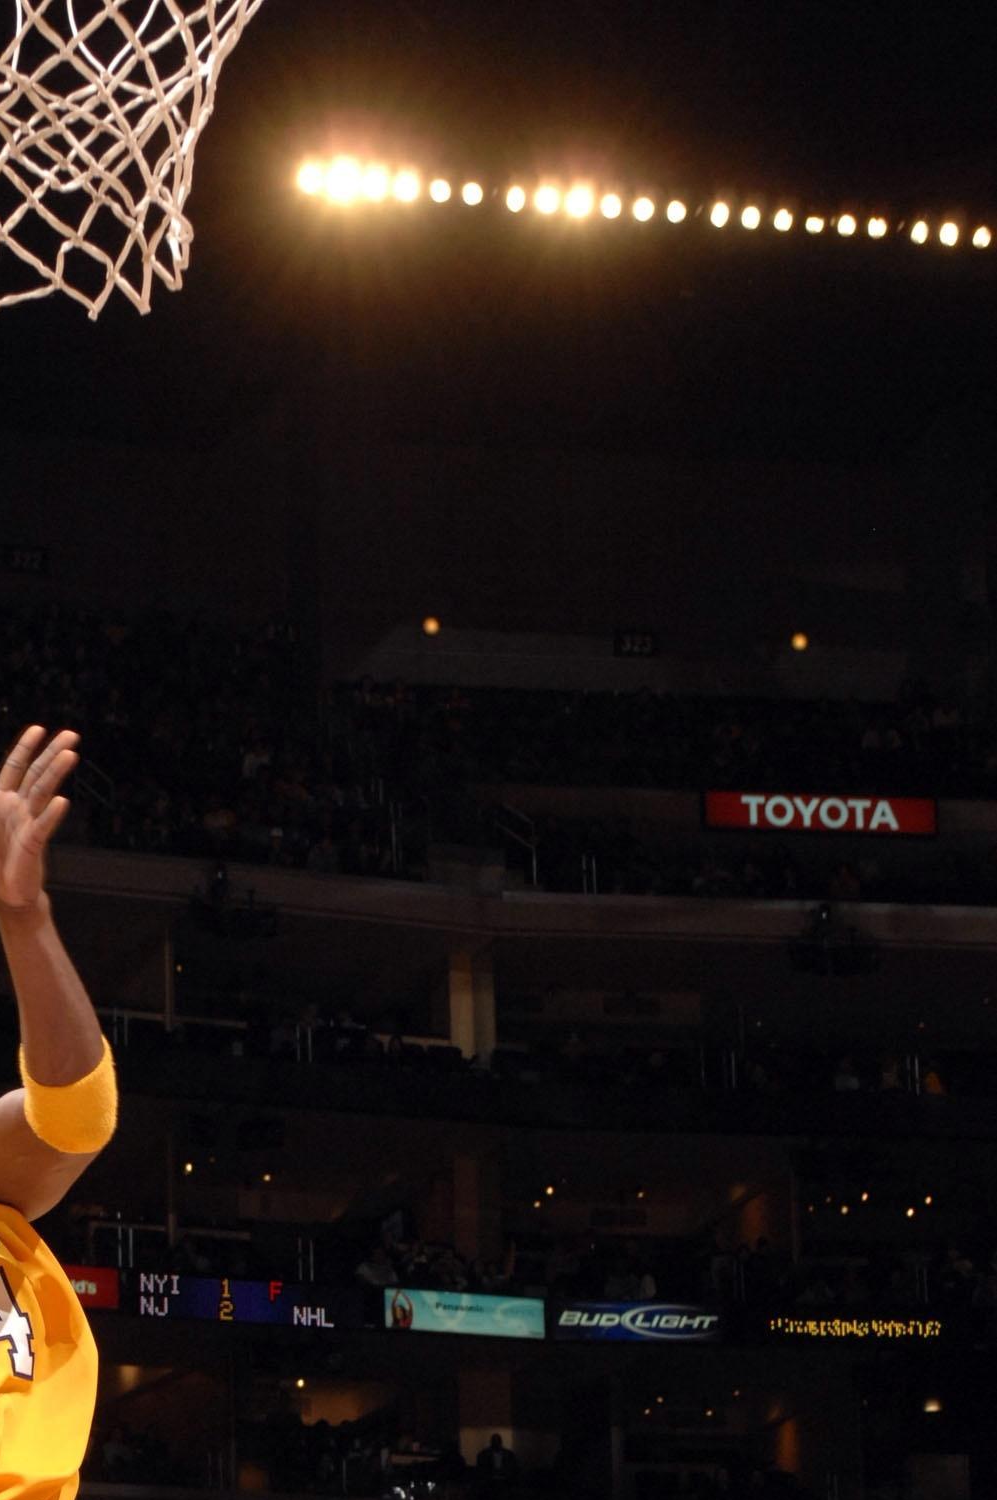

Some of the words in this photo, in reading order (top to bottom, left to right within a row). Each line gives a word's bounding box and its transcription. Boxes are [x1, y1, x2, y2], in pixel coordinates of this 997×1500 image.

[740, 795, 899, 831] TOYOTA
[140, 1272, 180, 1295] NYI
[221, 1278, 230, 1298] 1
[269, 1282, 283, 1300] F
[140, 1295, 168, 1316] NJ
[219, 1301, 233, 1320] 2
[293, 1306, 335, 1328] NHL
[558, 1310, 621, 1327] BUD
[633, 1312, 719, 1329] LIGHT
